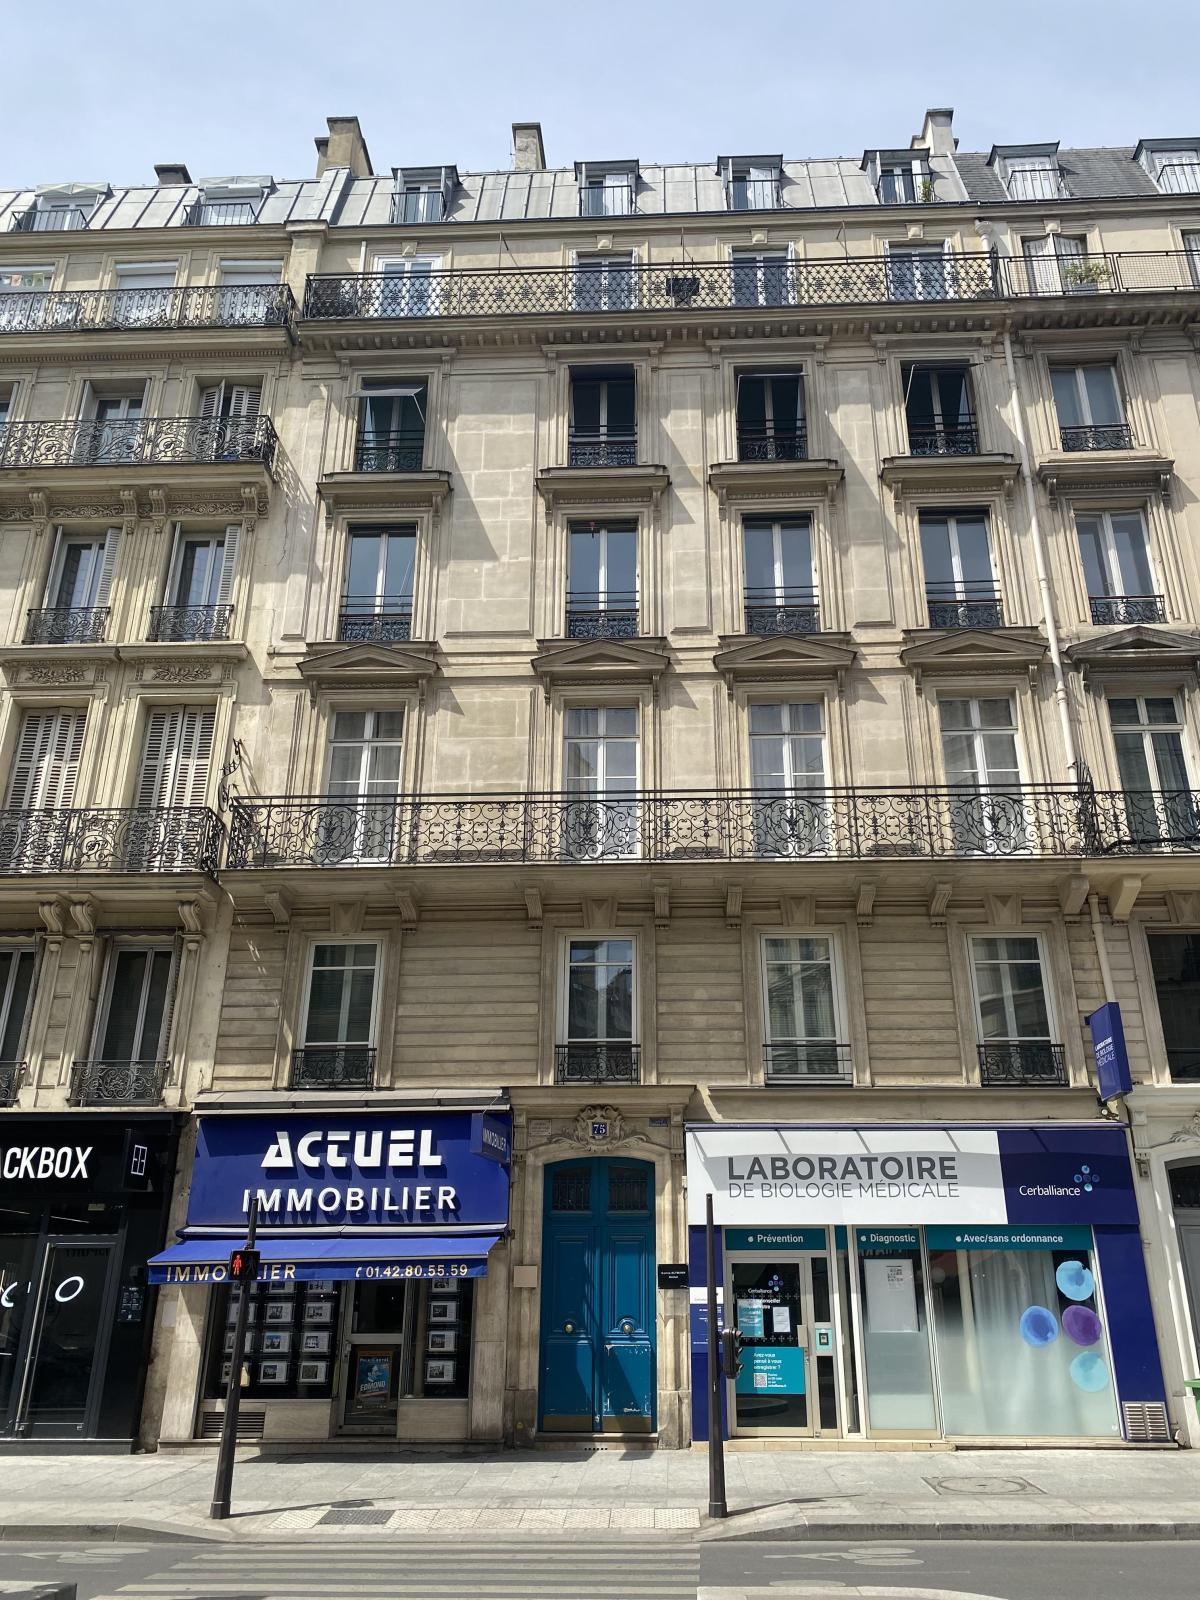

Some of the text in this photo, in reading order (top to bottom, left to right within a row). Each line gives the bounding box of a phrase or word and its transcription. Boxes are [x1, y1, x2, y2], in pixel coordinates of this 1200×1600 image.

[593, 1124, 606, 1134] 75
[261, 1130, 442, 1168] ACTUEL
[0, 1146, 93, 1179] CKBOX
[728, 1156, 959, 1180] LABORATOIRE
[729, 1179, 960, 1198] DE BIOLOGIE MÉDICALE
[1019, 1185, 1081, 1196] Cerballiance
[242, 1186, 456, 1212] IMMOBILIER
[757, 1233, 804, 1243] Prévention
[870, 1232, 916, 1244] Diagnostic
[963, 1233, 1063, 1244] Avec/sans ordonnance
[365, 1264, 468, 1278] 01.42.80.55.59
